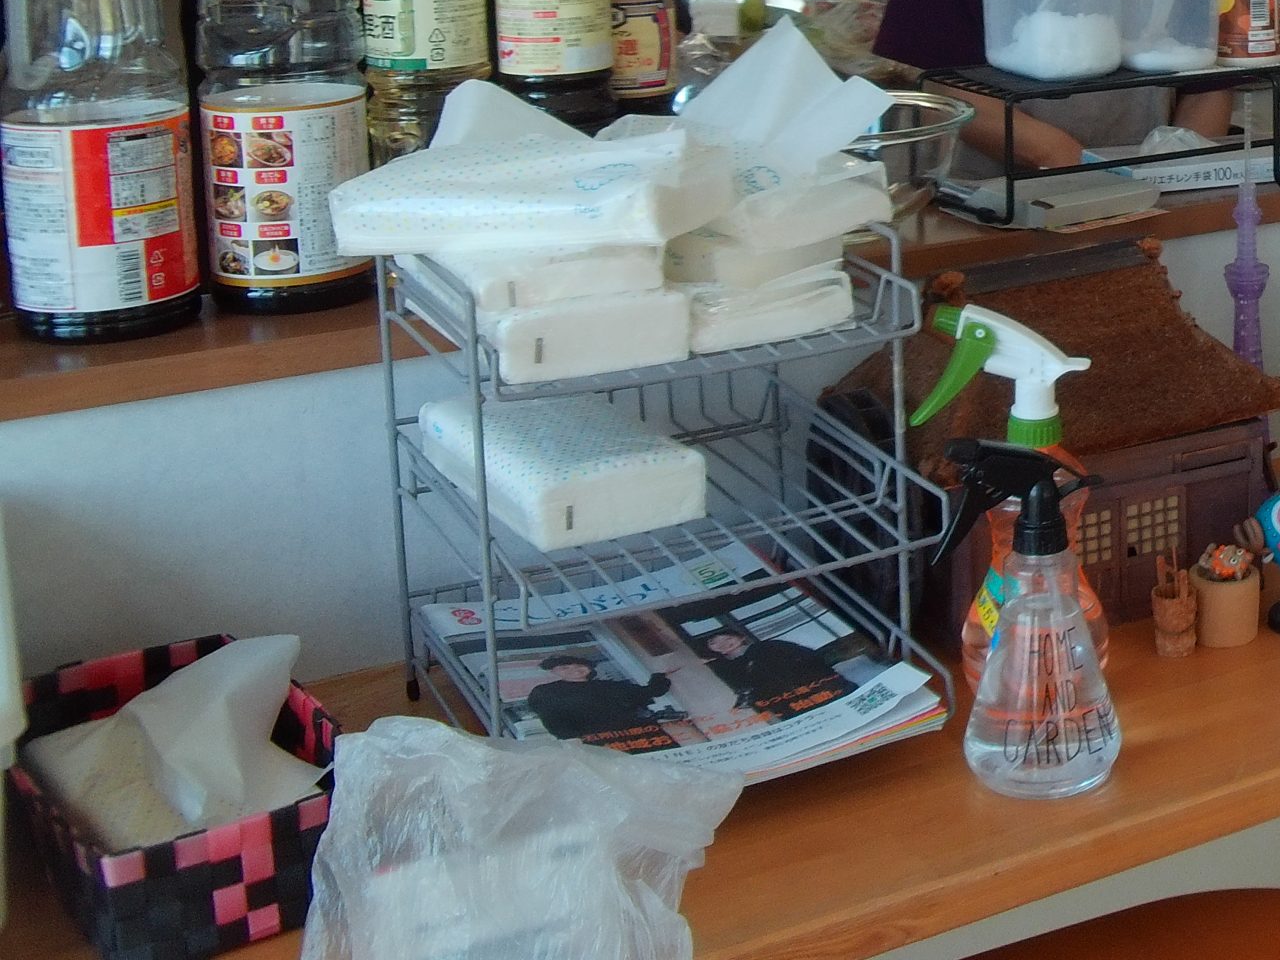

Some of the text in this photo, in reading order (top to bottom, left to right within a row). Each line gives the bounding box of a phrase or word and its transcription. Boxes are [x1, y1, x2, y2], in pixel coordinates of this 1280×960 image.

[1027, 626, 1084, 678] HOME
[1042, 685, 1077, 717] AND
[1003, 708, 1115, 765] GARDEN
